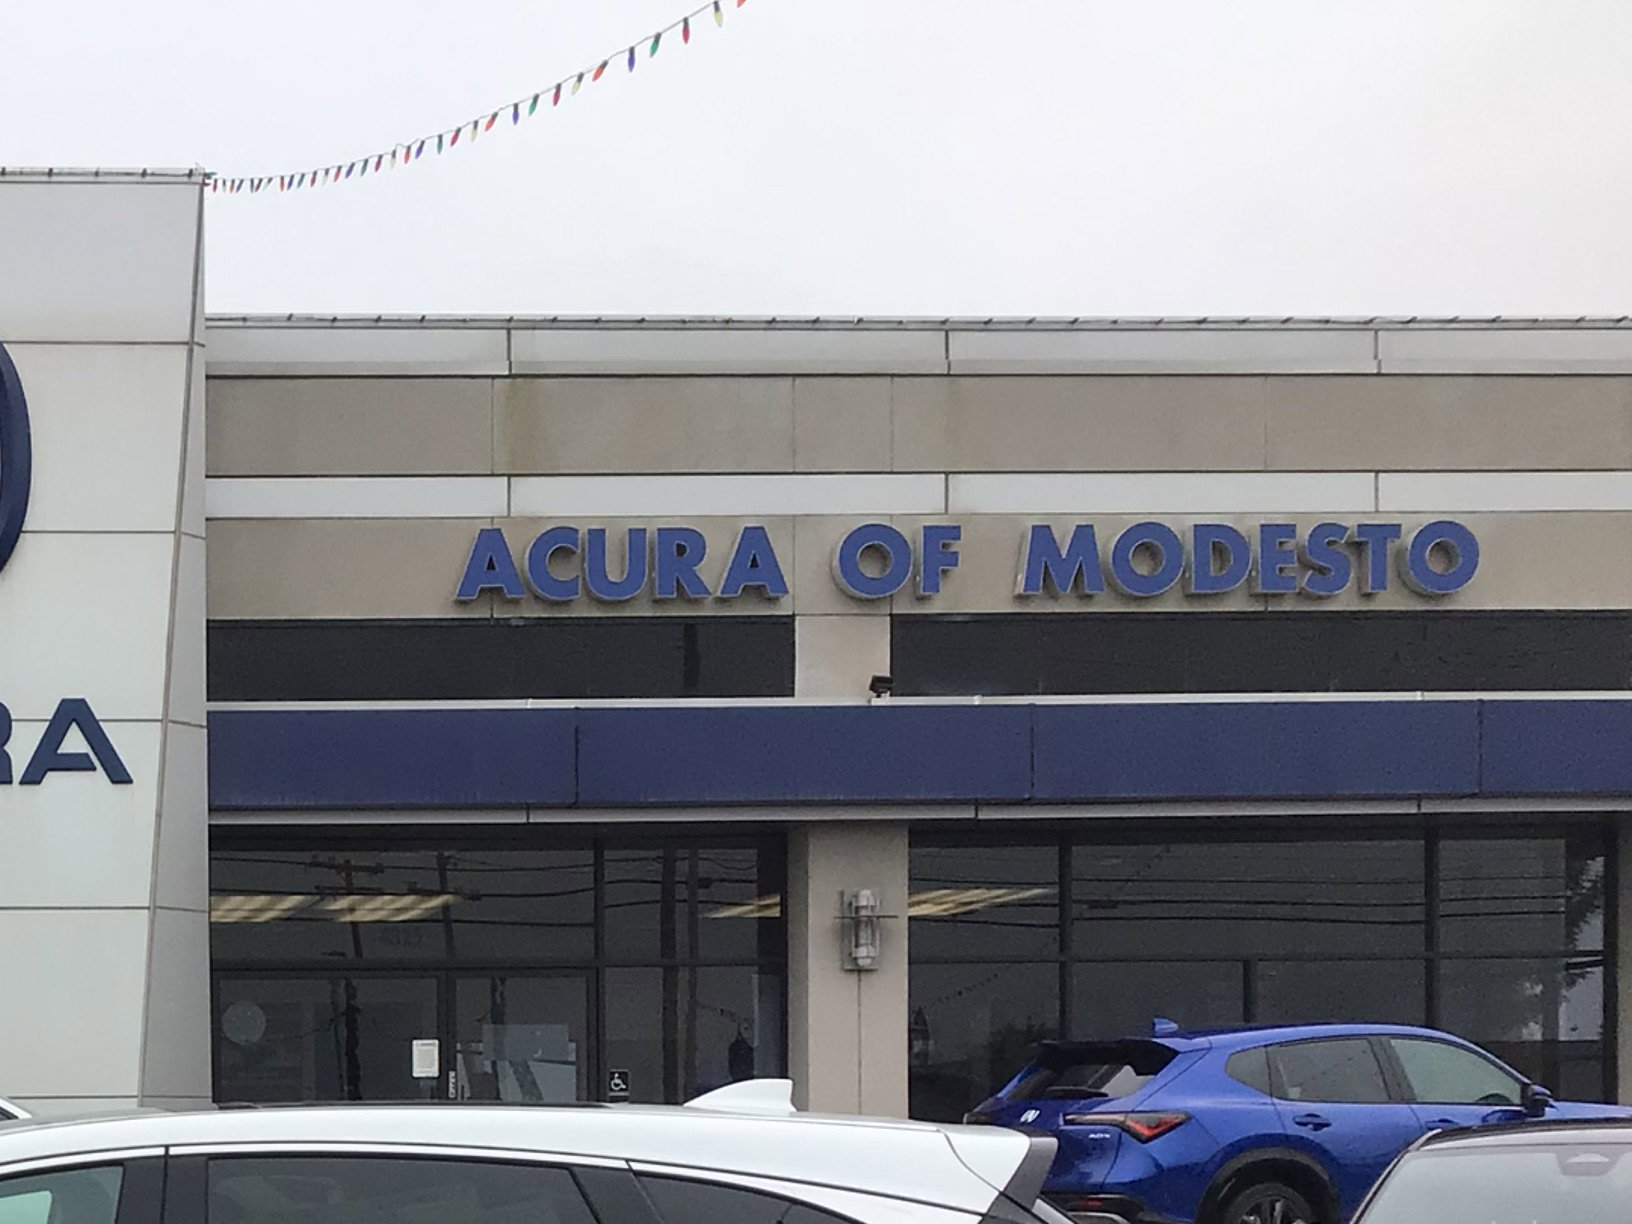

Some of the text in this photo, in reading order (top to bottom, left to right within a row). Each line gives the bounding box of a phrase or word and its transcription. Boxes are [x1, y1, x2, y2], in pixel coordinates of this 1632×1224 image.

[455, 518, 1481, 602] ACURA OF MODESTO
